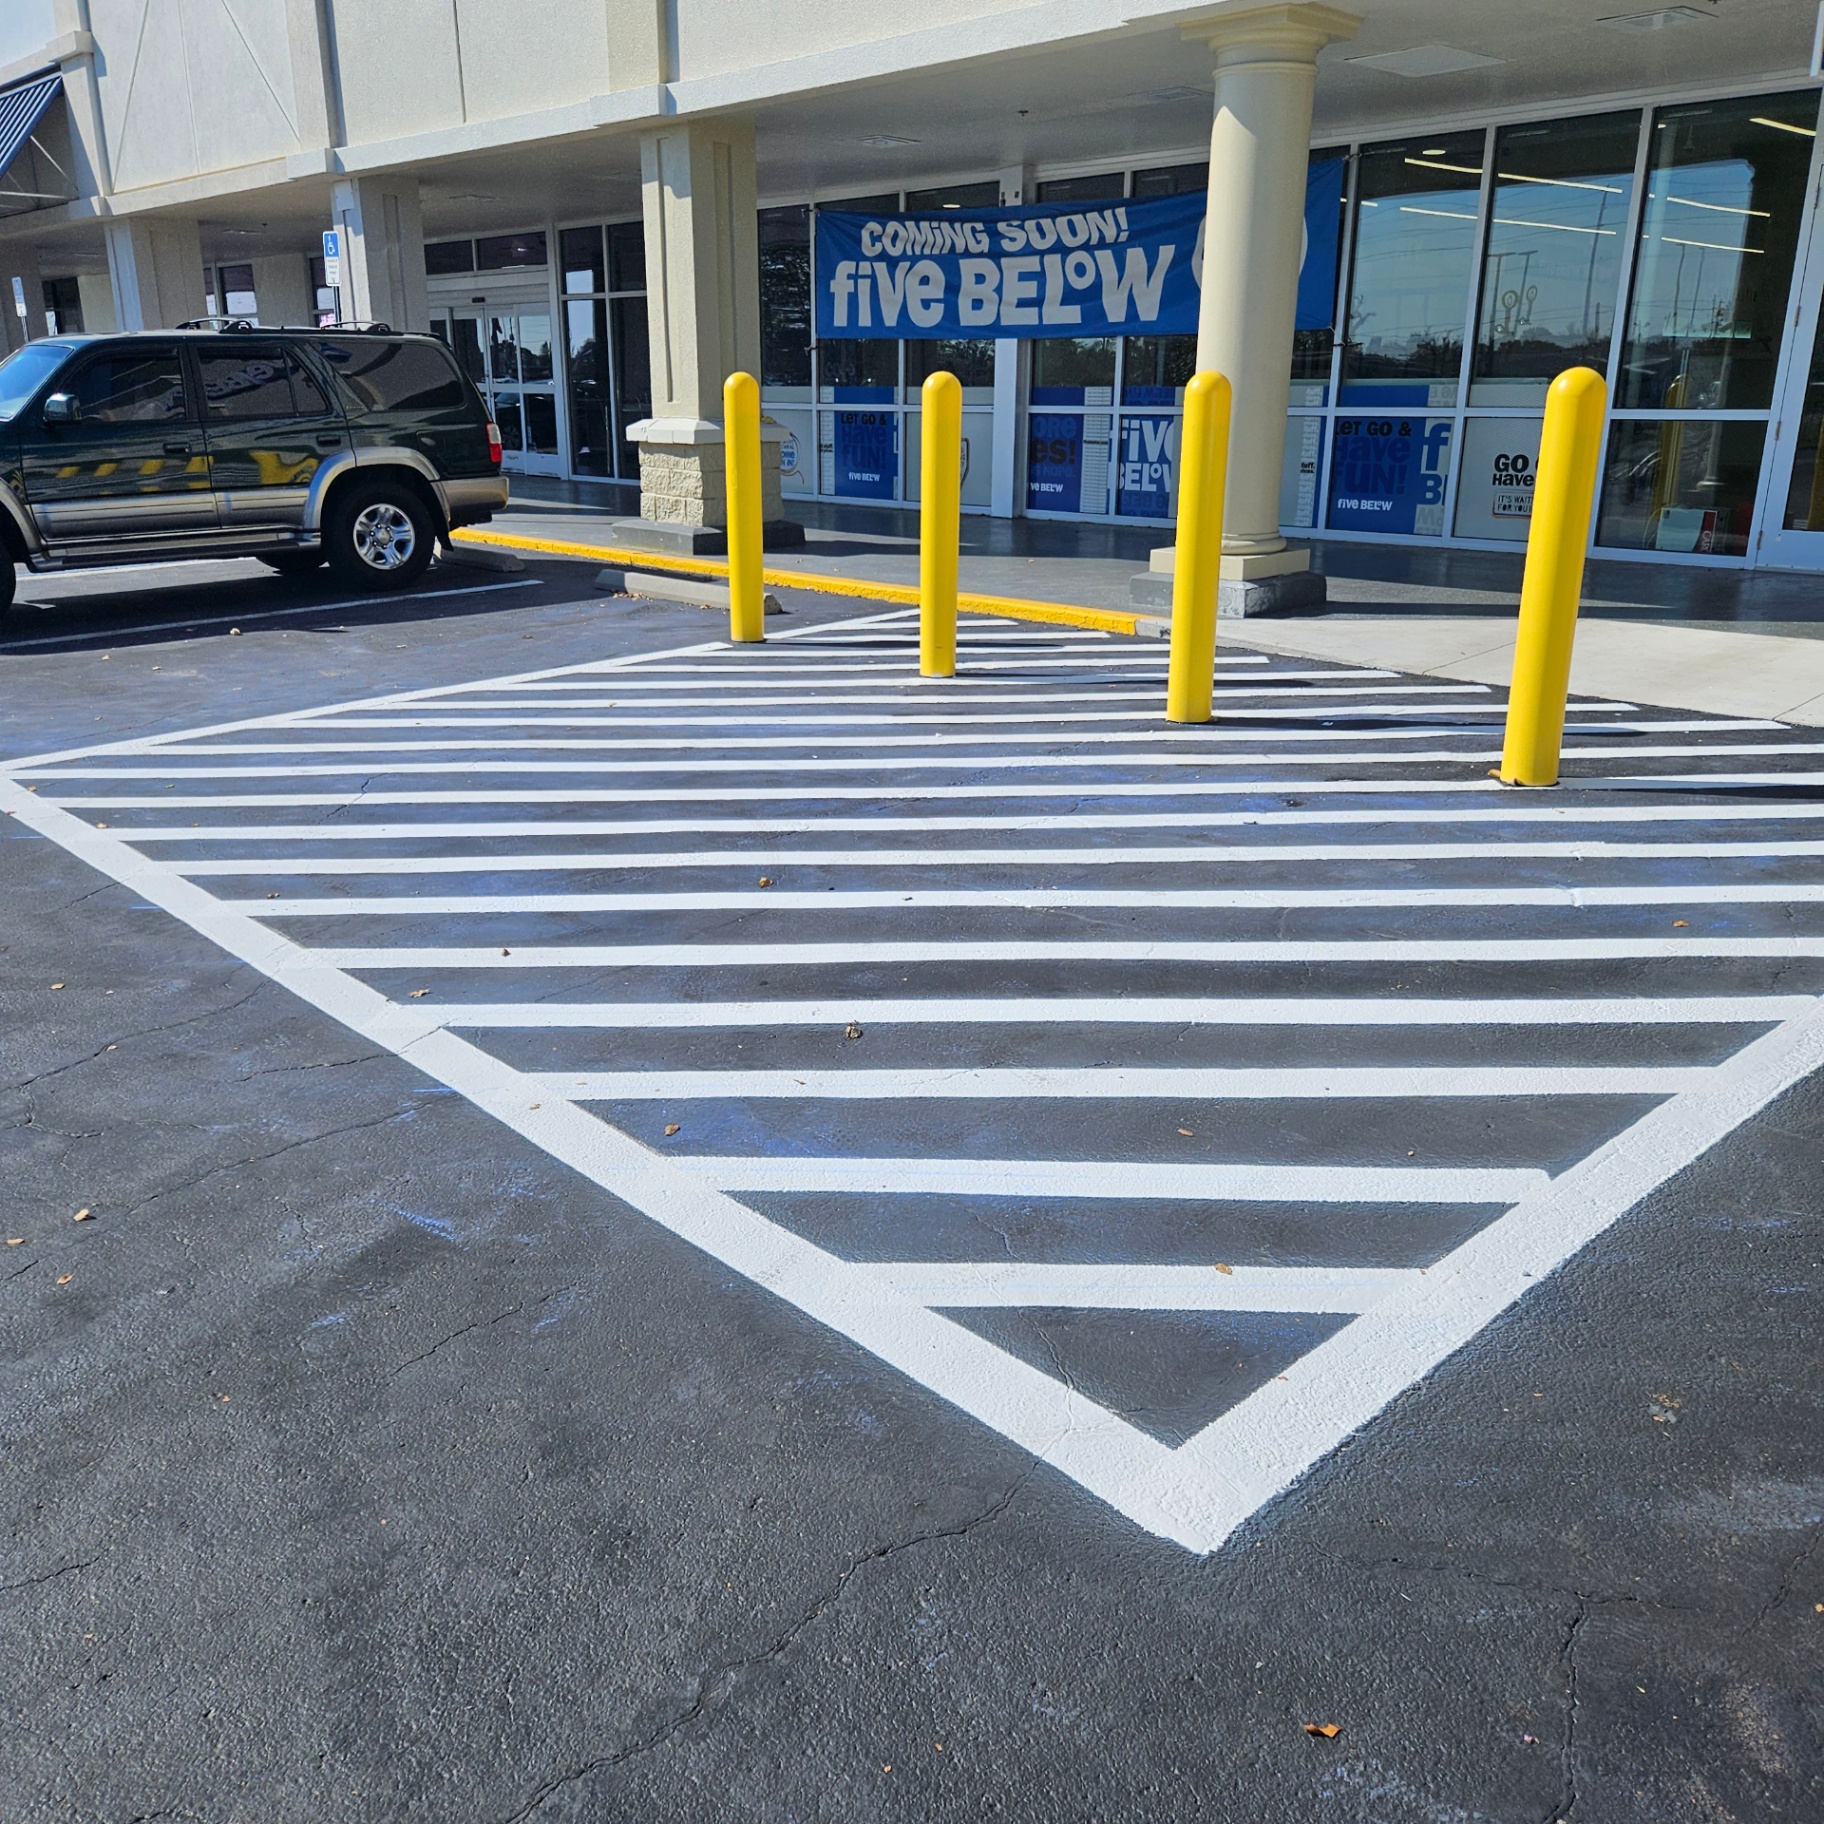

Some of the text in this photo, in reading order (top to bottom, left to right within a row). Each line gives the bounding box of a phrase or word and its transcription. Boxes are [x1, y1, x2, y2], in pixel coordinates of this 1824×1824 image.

[997, 207, 1130, 252] SOON!
[830, 245, 1175, 328] five BELOW
[861, 413, 876, 425] GO
[879, 413, 887, 425] &
[1366, 421, 1393, 437] GO
[1398, 421, 1412, 437] &
[1494, 454, 1529, 473] GO
[1031, 482, 1040, 491] ve
[1492, 474, 1535, 487] Have
[1337, 499, 1393, 511] five BELOW
[1514, 495, 1533, 504] WAIT
[1498, 504, 1511, 512] FOR
